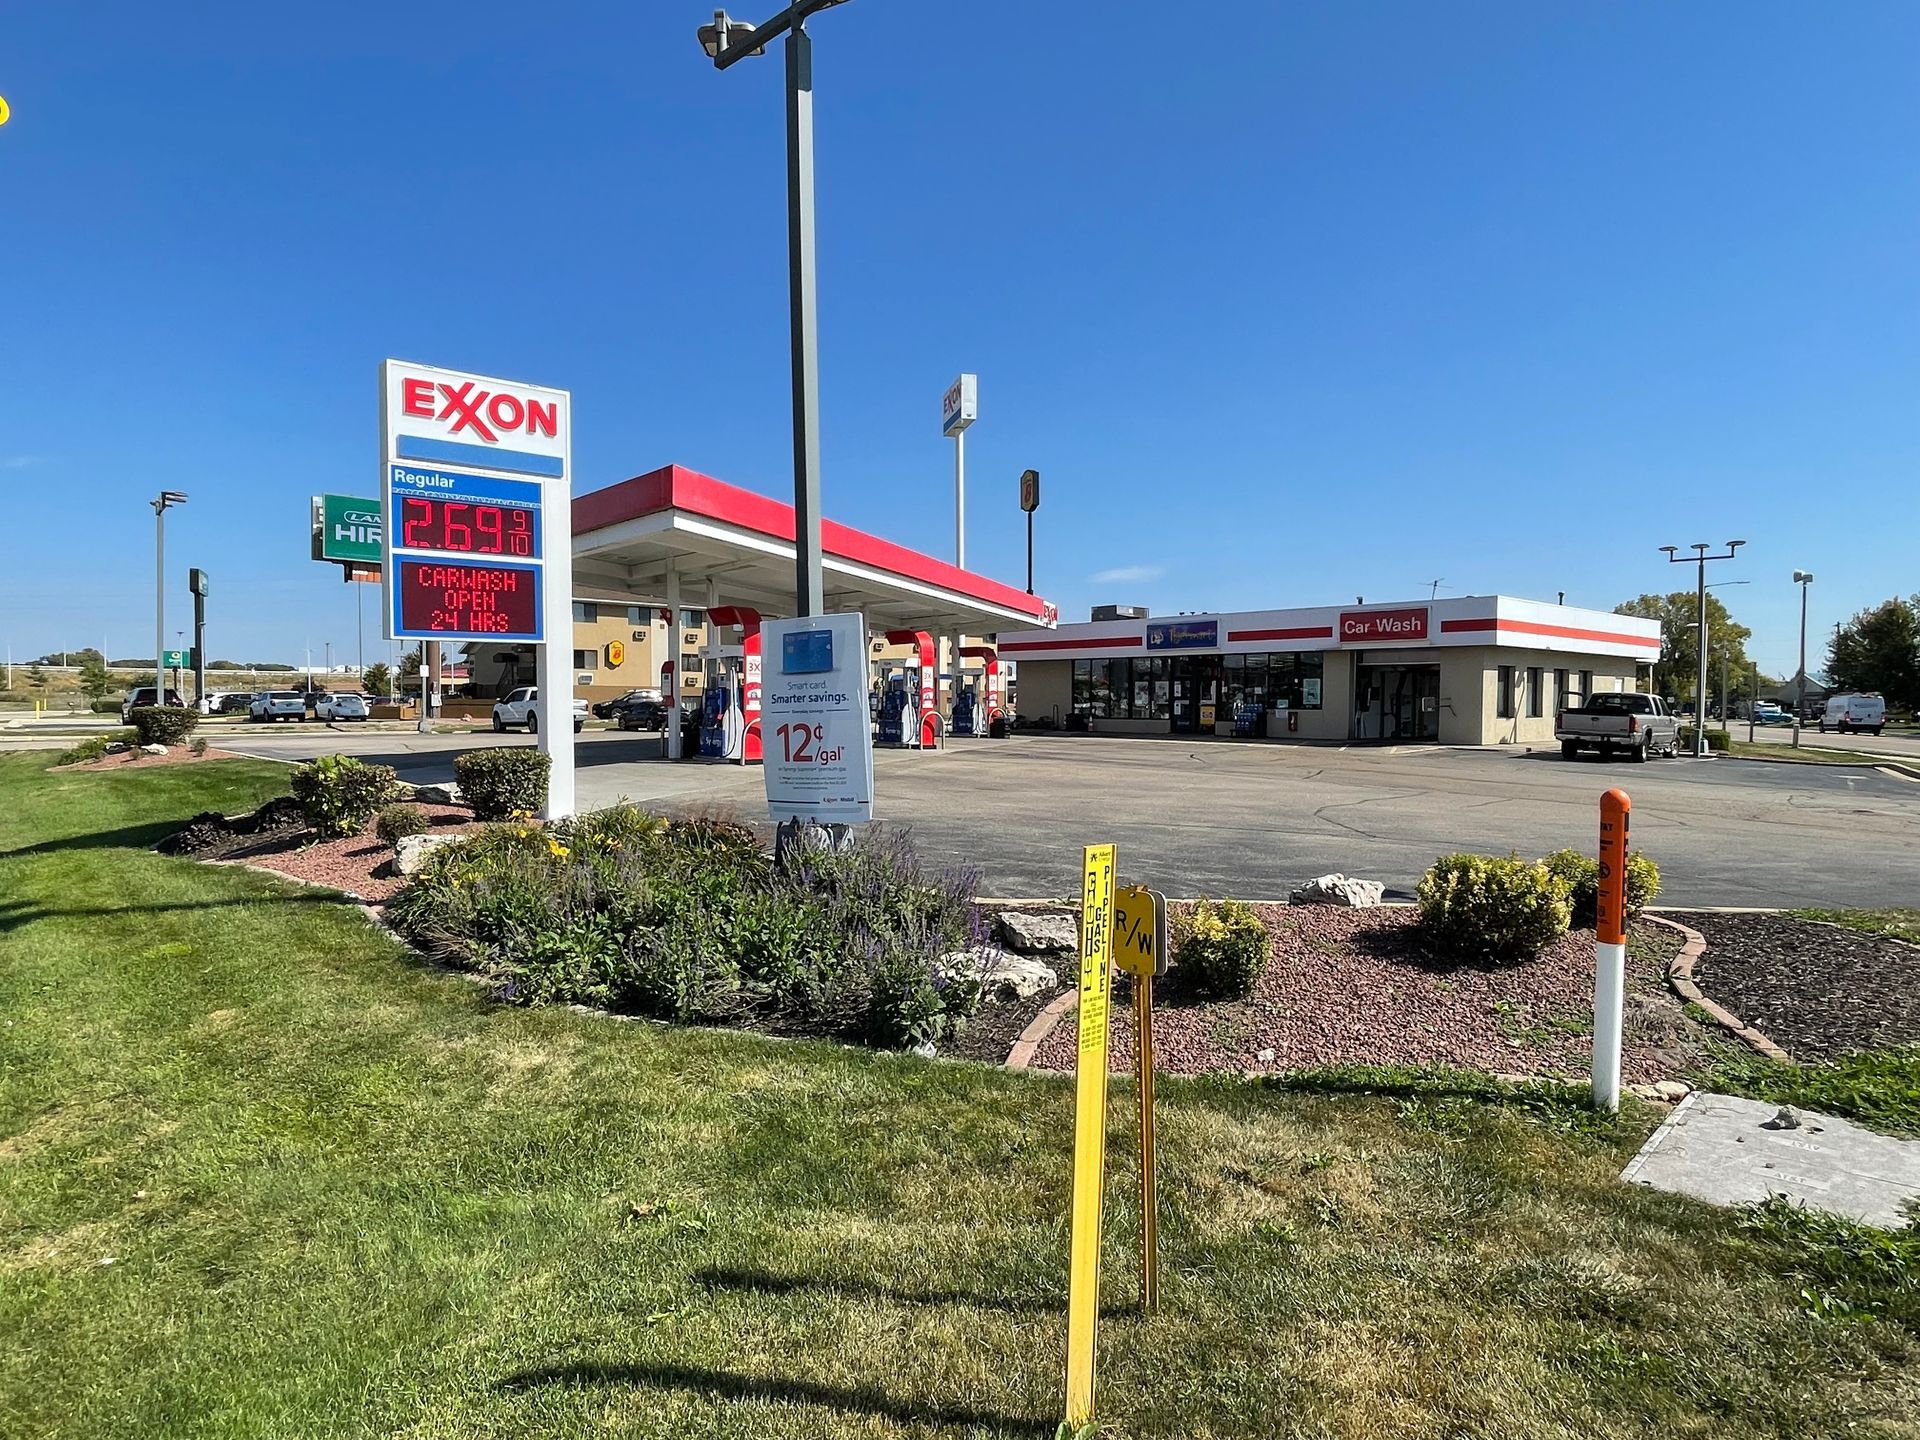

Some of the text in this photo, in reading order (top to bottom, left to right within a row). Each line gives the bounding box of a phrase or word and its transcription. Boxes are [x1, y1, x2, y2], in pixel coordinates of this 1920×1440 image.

[402, 377, 557, 442] EXXON
[394, 469, 455, 488] Regular
[404, 499, 502, 553] 2.69
[418, 566, 516, 592] CARWASH
[444, 589, 495, 611] OPEN
[431, 610, 509, 632] 24 HRS
[1344, 616, 1421, 634] Car Wash
[771, 690, 850, 705] Smarter savings.
[787, 681, 808, 690] Smart
[1093, 907, 1102, 953] GAS
[1099, 866, 1110, 992] PIPELINE
[1115, 909, 1153, 956] R/W
